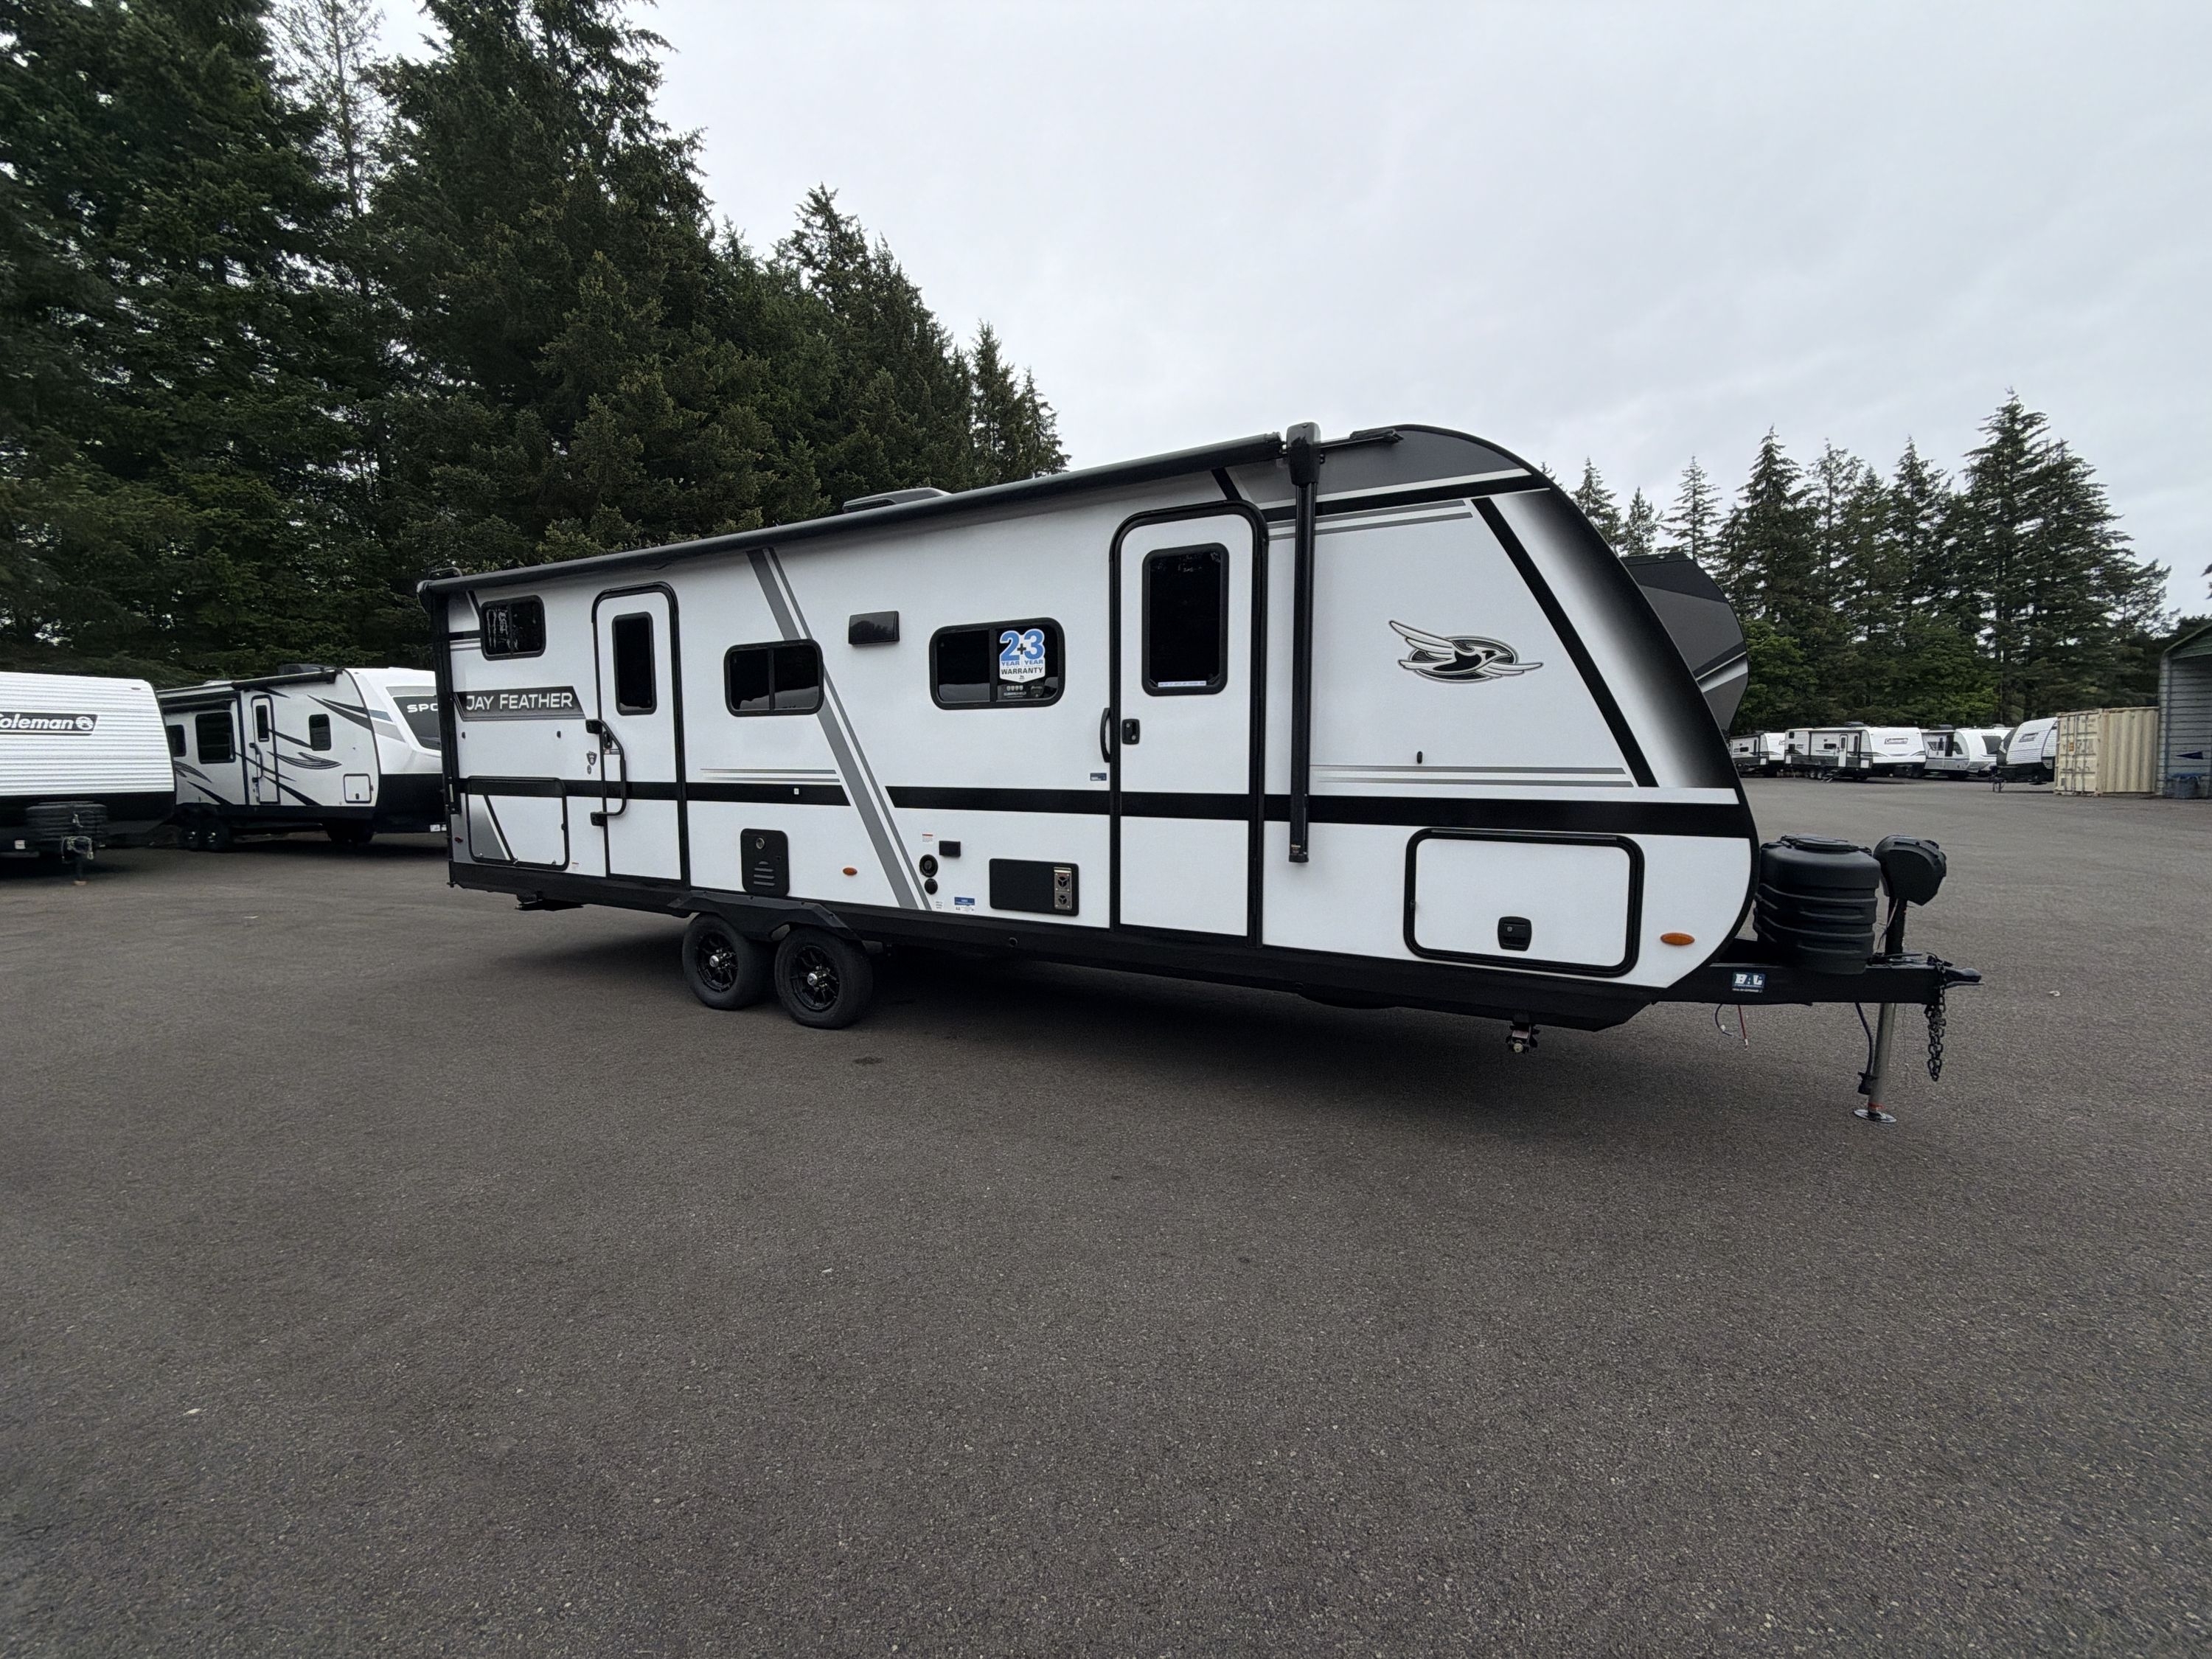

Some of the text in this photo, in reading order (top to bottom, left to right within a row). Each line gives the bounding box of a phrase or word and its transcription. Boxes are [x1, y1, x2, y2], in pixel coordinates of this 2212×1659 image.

[1001, 667, 1043, 675] WARRANTY
[466, 692, 573, 711] JAY FEATHER
[0, 713, 74, 729] oleman
